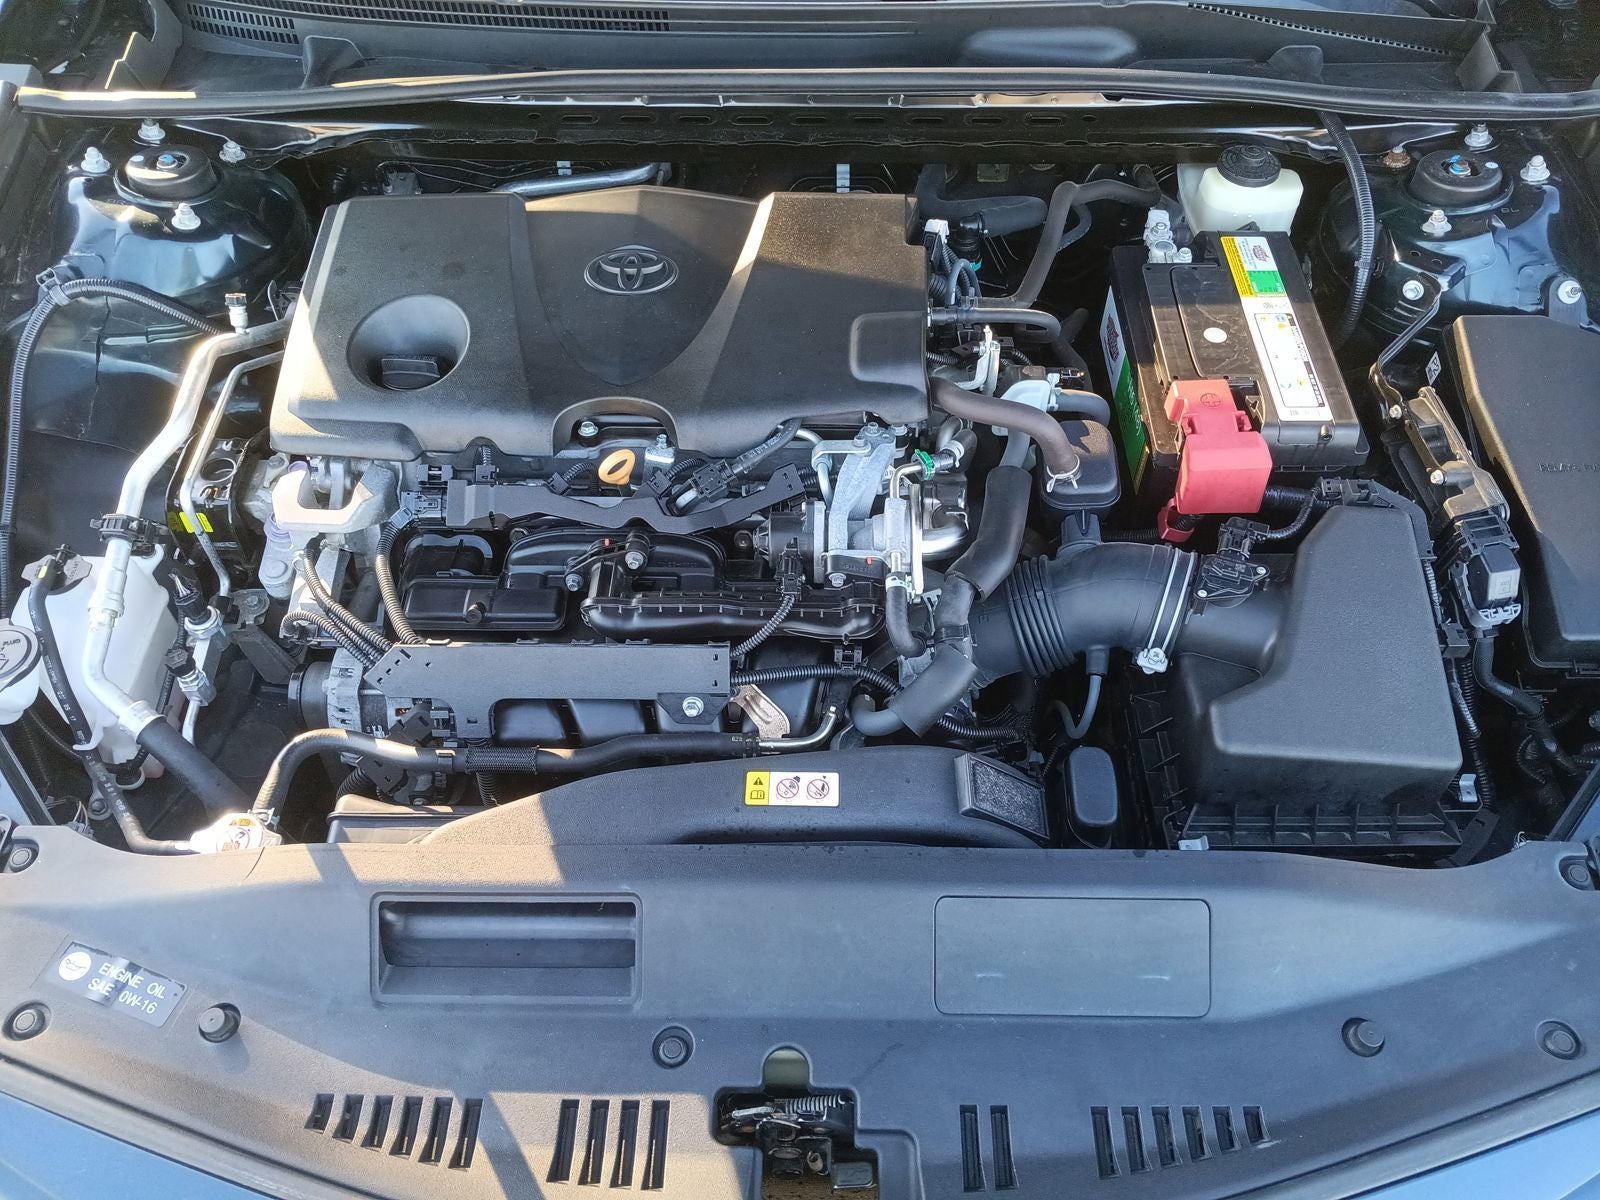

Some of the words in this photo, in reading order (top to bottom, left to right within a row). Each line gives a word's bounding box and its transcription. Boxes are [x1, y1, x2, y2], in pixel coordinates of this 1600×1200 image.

[87, 977, 115, 996] SAE
[118, 990, 158, 1014] 0W-16
[98, 962, 144, 989] ENGINE
[146, 982, 166, 999] OIL
